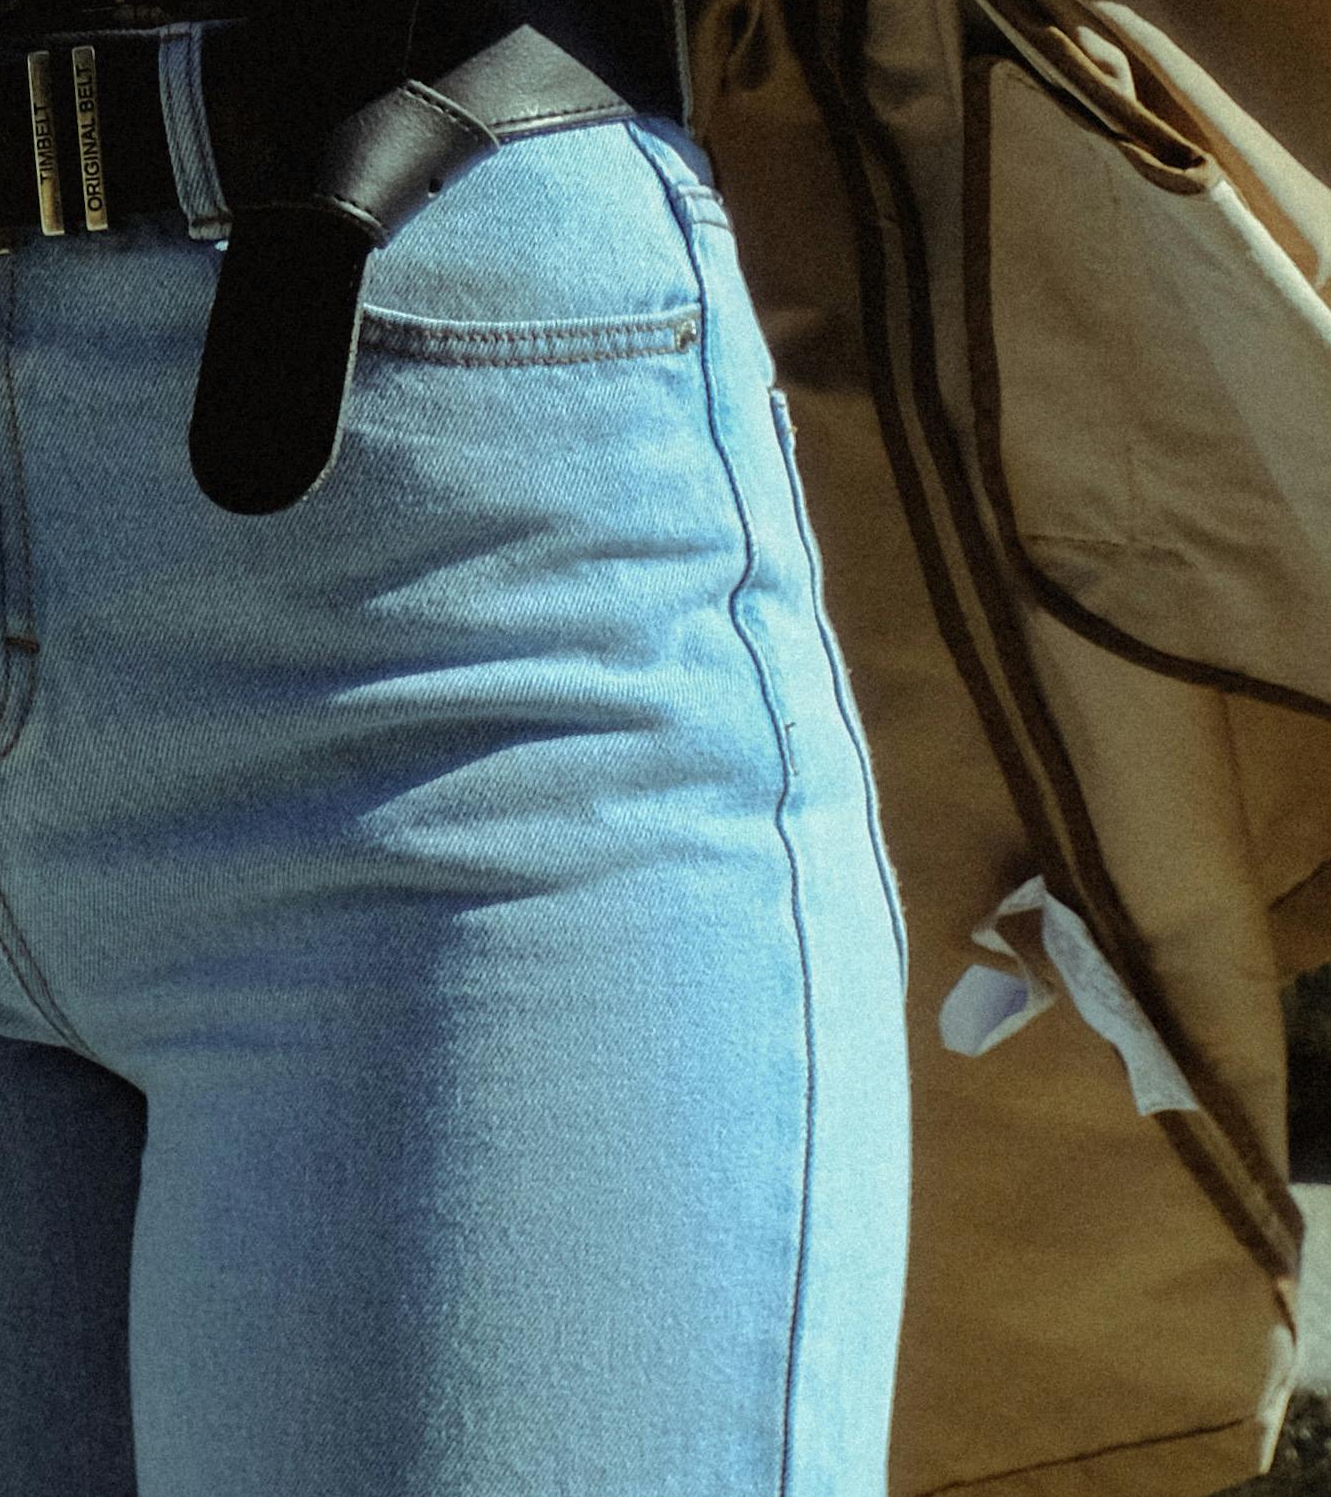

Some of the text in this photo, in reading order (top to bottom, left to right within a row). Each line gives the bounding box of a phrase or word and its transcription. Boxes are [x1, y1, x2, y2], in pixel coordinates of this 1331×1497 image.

[35, 102, 54, 186] TIMBELT
[76, 63, 103, 211] ORIGINAL BELT
